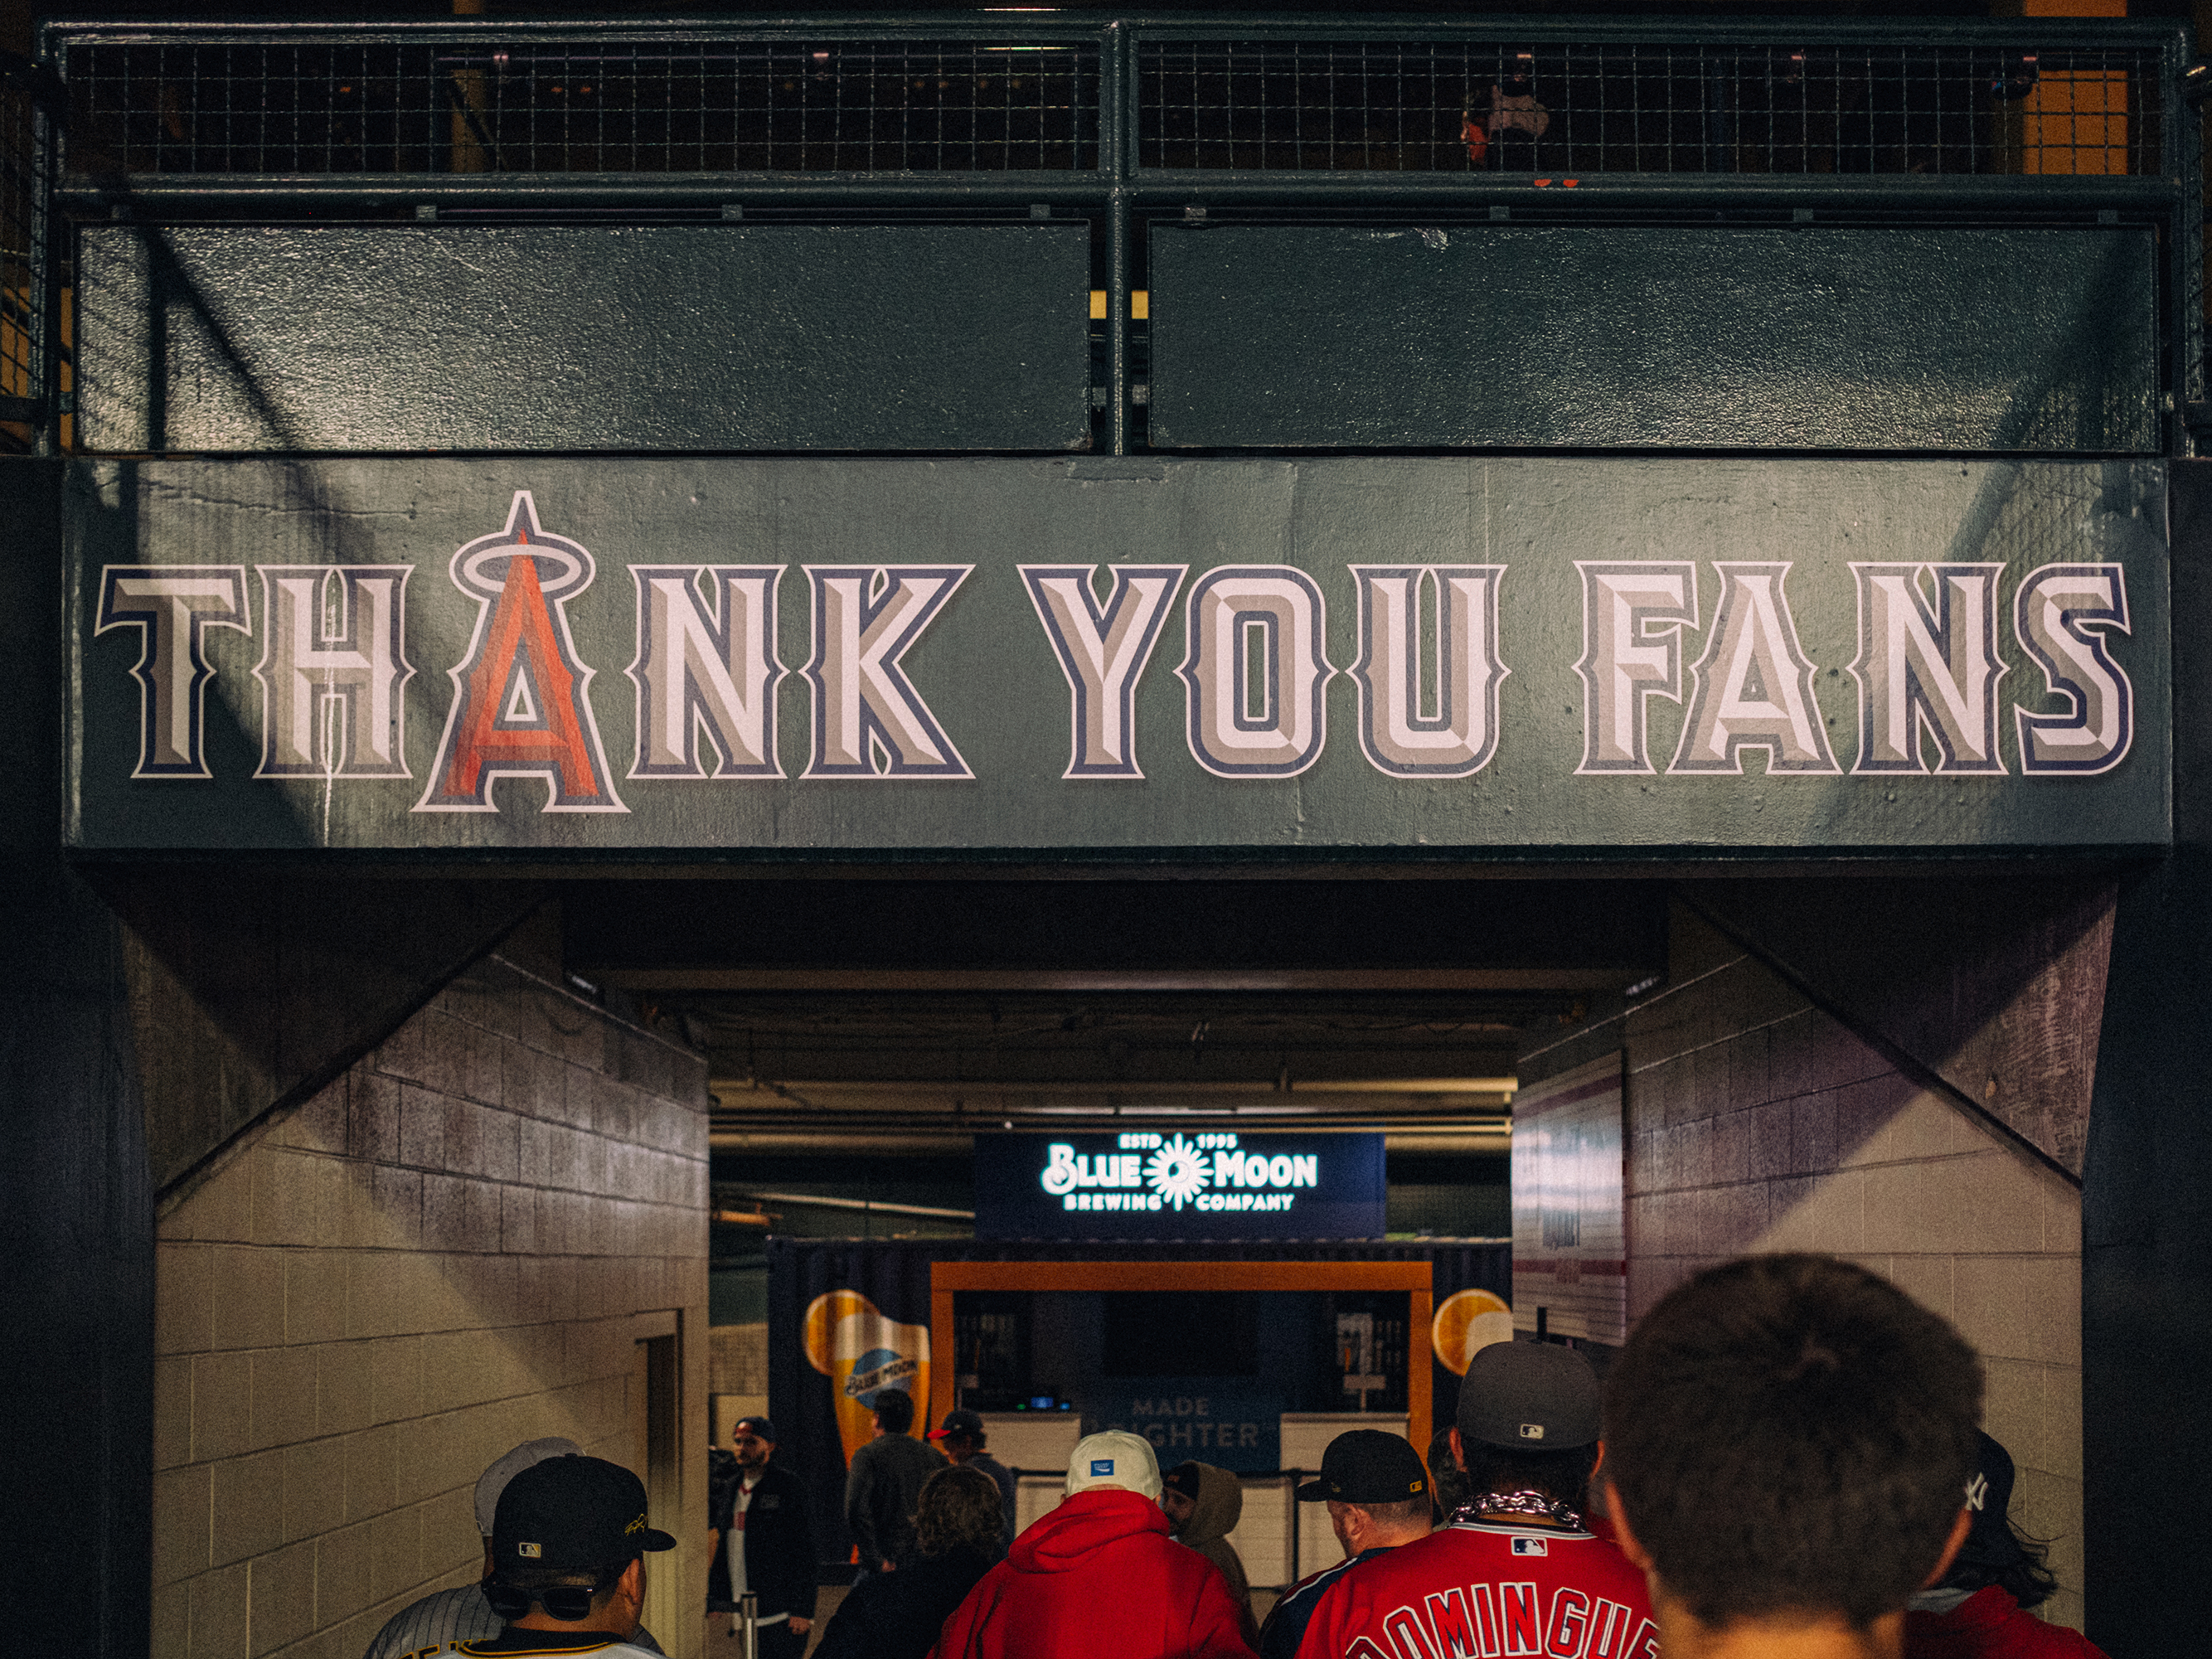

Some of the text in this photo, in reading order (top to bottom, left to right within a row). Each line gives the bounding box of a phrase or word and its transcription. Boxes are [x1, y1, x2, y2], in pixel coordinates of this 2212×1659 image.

[94, 489, 2136, 813] THANK YOU FANS
[1213, 1150, 1317, 1187] MOON
[1063, 1193, 1295, 1211] BREWING COMPANY
[1133, 1398, 1210, 1416] MADE
